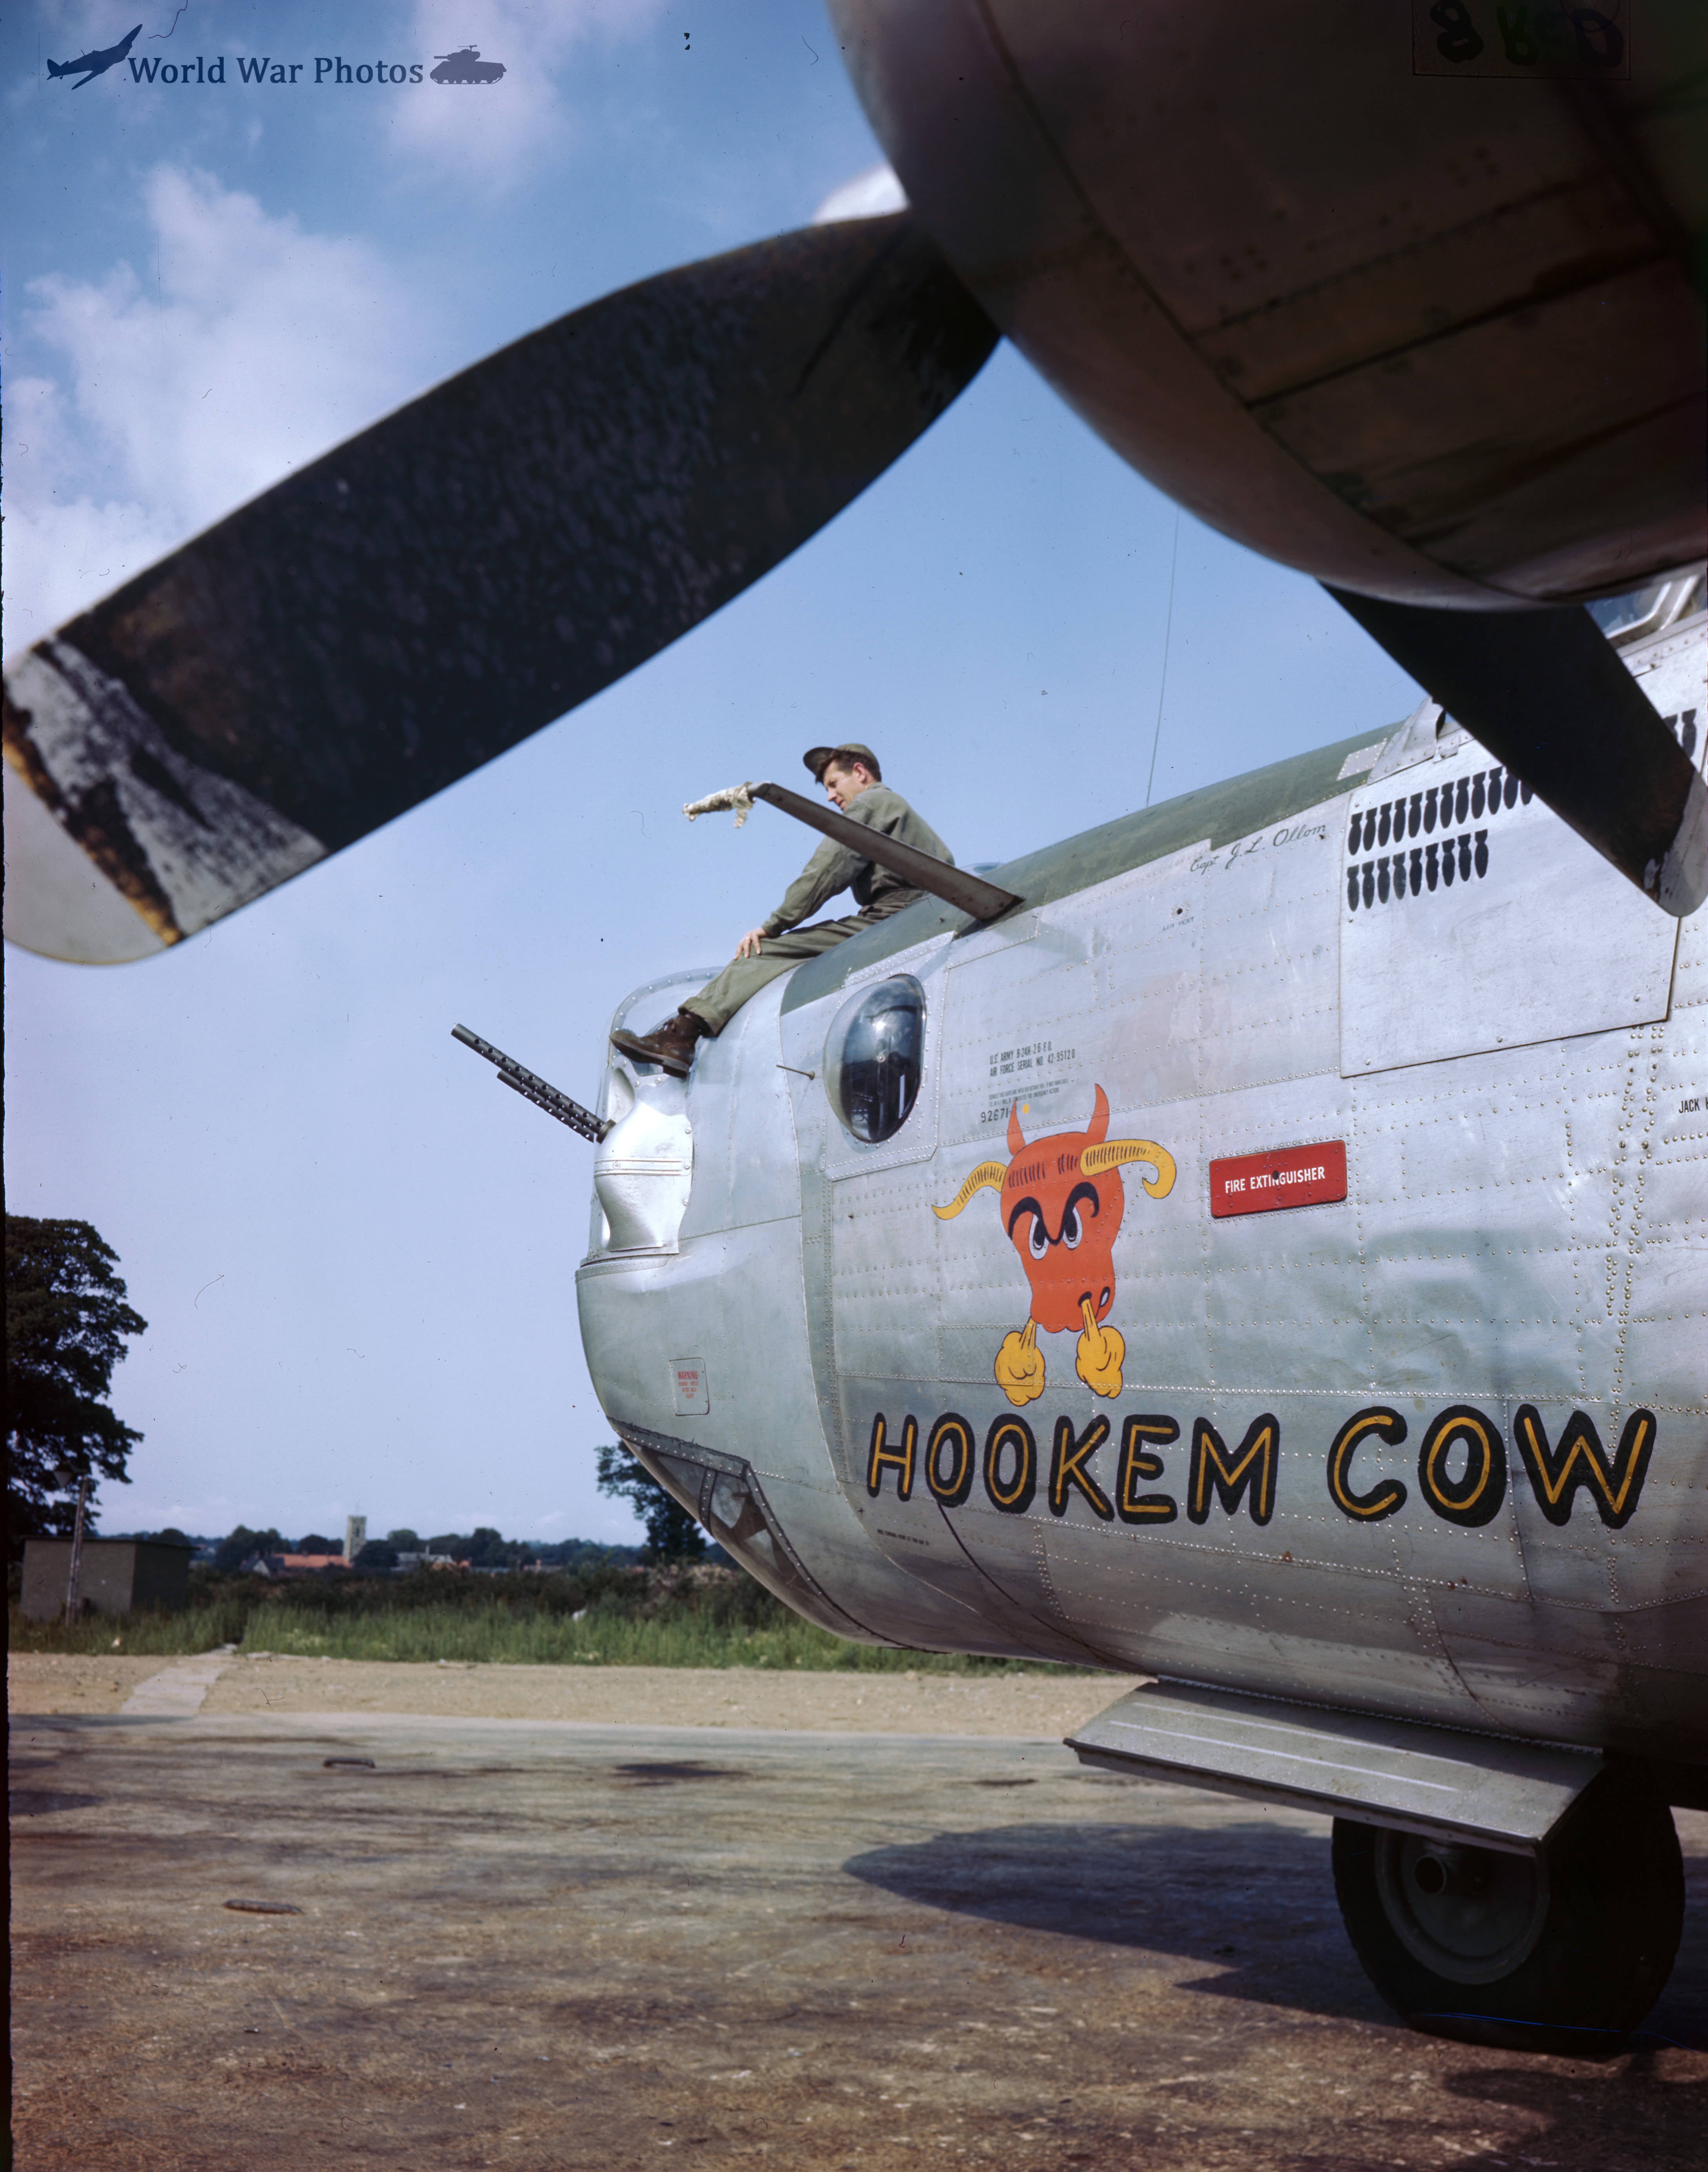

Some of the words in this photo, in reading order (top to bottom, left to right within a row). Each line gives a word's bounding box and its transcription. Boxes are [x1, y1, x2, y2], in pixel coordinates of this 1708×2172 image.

[989, 1066, 998, 1077] AIR
[1000, 1062, 1014, 1075] FORCE
[1017, 1058, 1033, 1071] SERIAL
[1036, 1056, 1044, 1066] NO.
[1047, 1048, 1075, 1064] 42-95120
[1000, 1050, 1014, 1062] ARMY
[1679, 1098, 1700, 1113] JACK
[1225, 1178, 1246, 1193] FIRE
[677, 1371, 698, 1380] WARNING
[866, 1412, 1280, 1526] HOOKEM
[1327, 1403, 1657, 1529] COW
